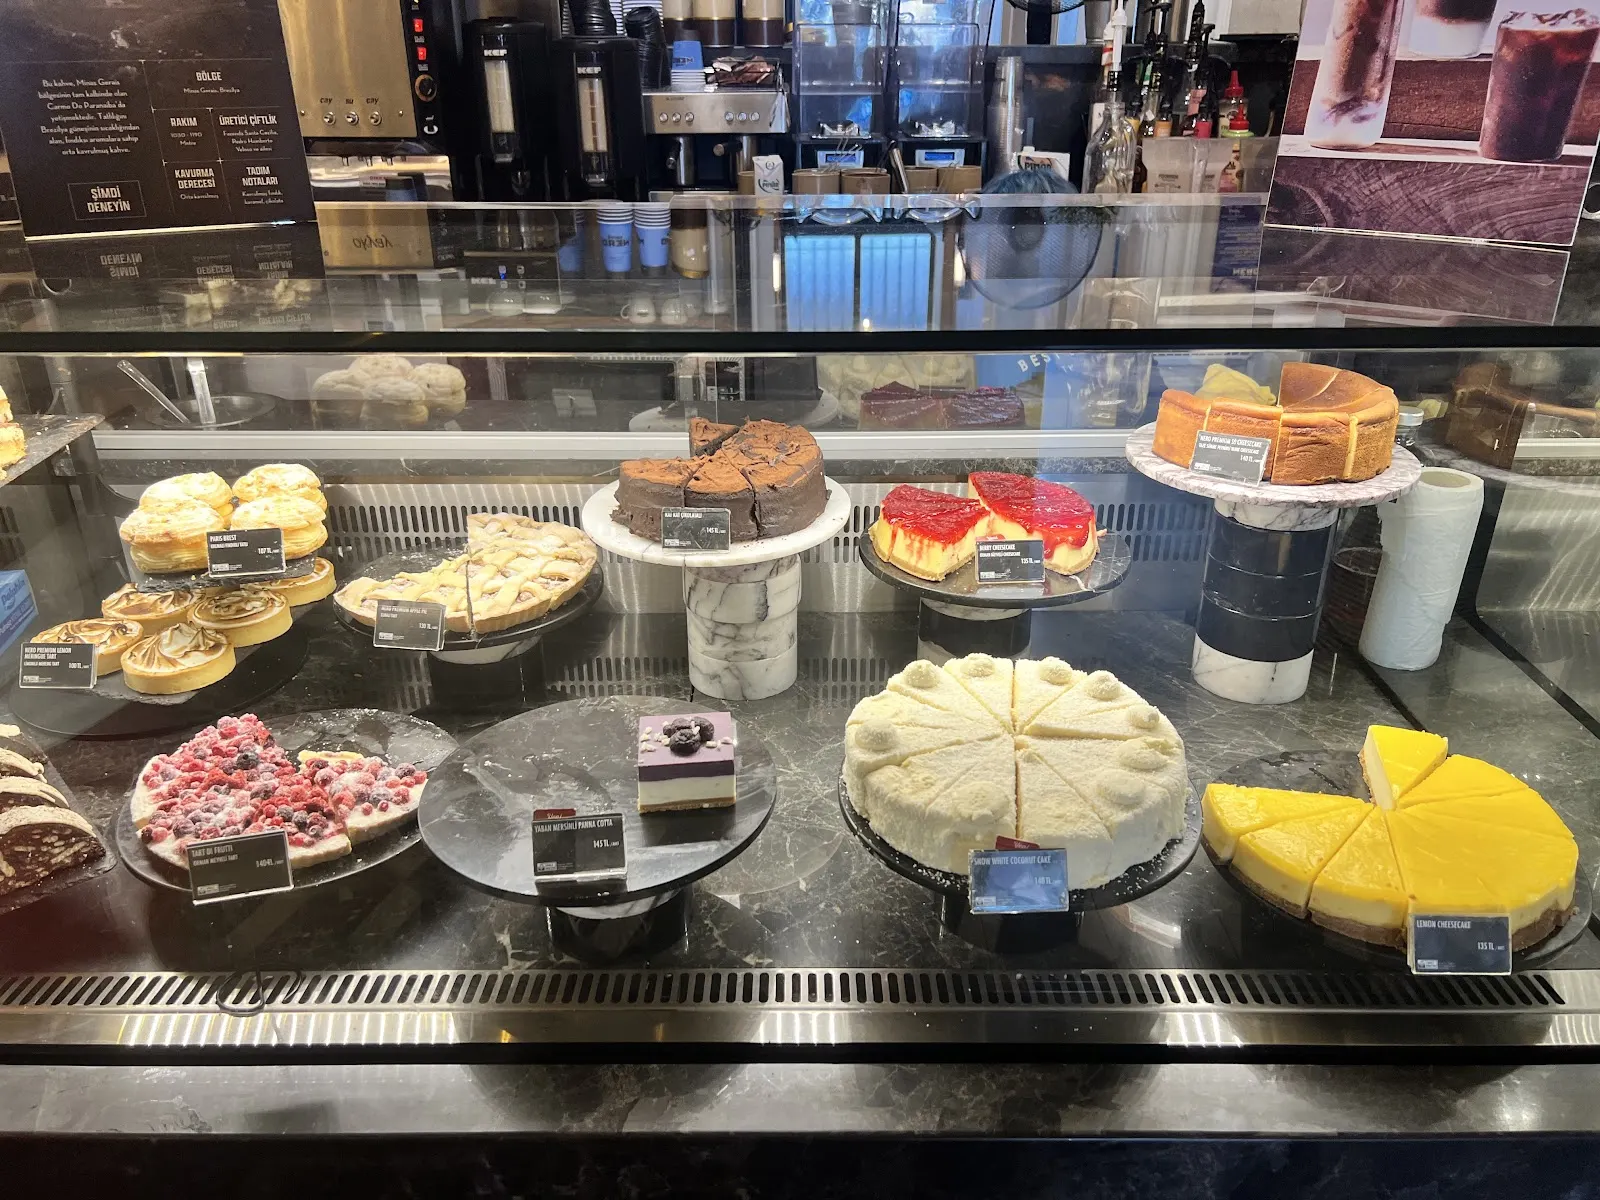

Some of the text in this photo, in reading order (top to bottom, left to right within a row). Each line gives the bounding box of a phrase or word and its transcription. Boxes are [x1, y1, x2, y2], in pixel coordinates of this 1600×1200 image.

[196, 71, 222, 81] BÖLGE
[170, 117, 197, 126] RAKIM
[219, 114, 277, 126] ÜRETİCİ ÇİFTLİK
[175, 168, 214, 178] KAVURMA
[246, 166, 270, 175] TADIM
[178, 178, 216, 189] DERECESİ
[242, 177, 278, 186] NOTALARI
[91, 185, 121, 201] ŞİMDİ
[87, 199, 130, 213] DENEYİN
[553, 821, 577, 831] MERSİNLİ
[578, 820, 596, 829] PANNA
[214, 845, 233, 854] FRUTTI
[1011, 856, 1036, 864] COCONUT
[1478, 942, 1487, 950] 135
